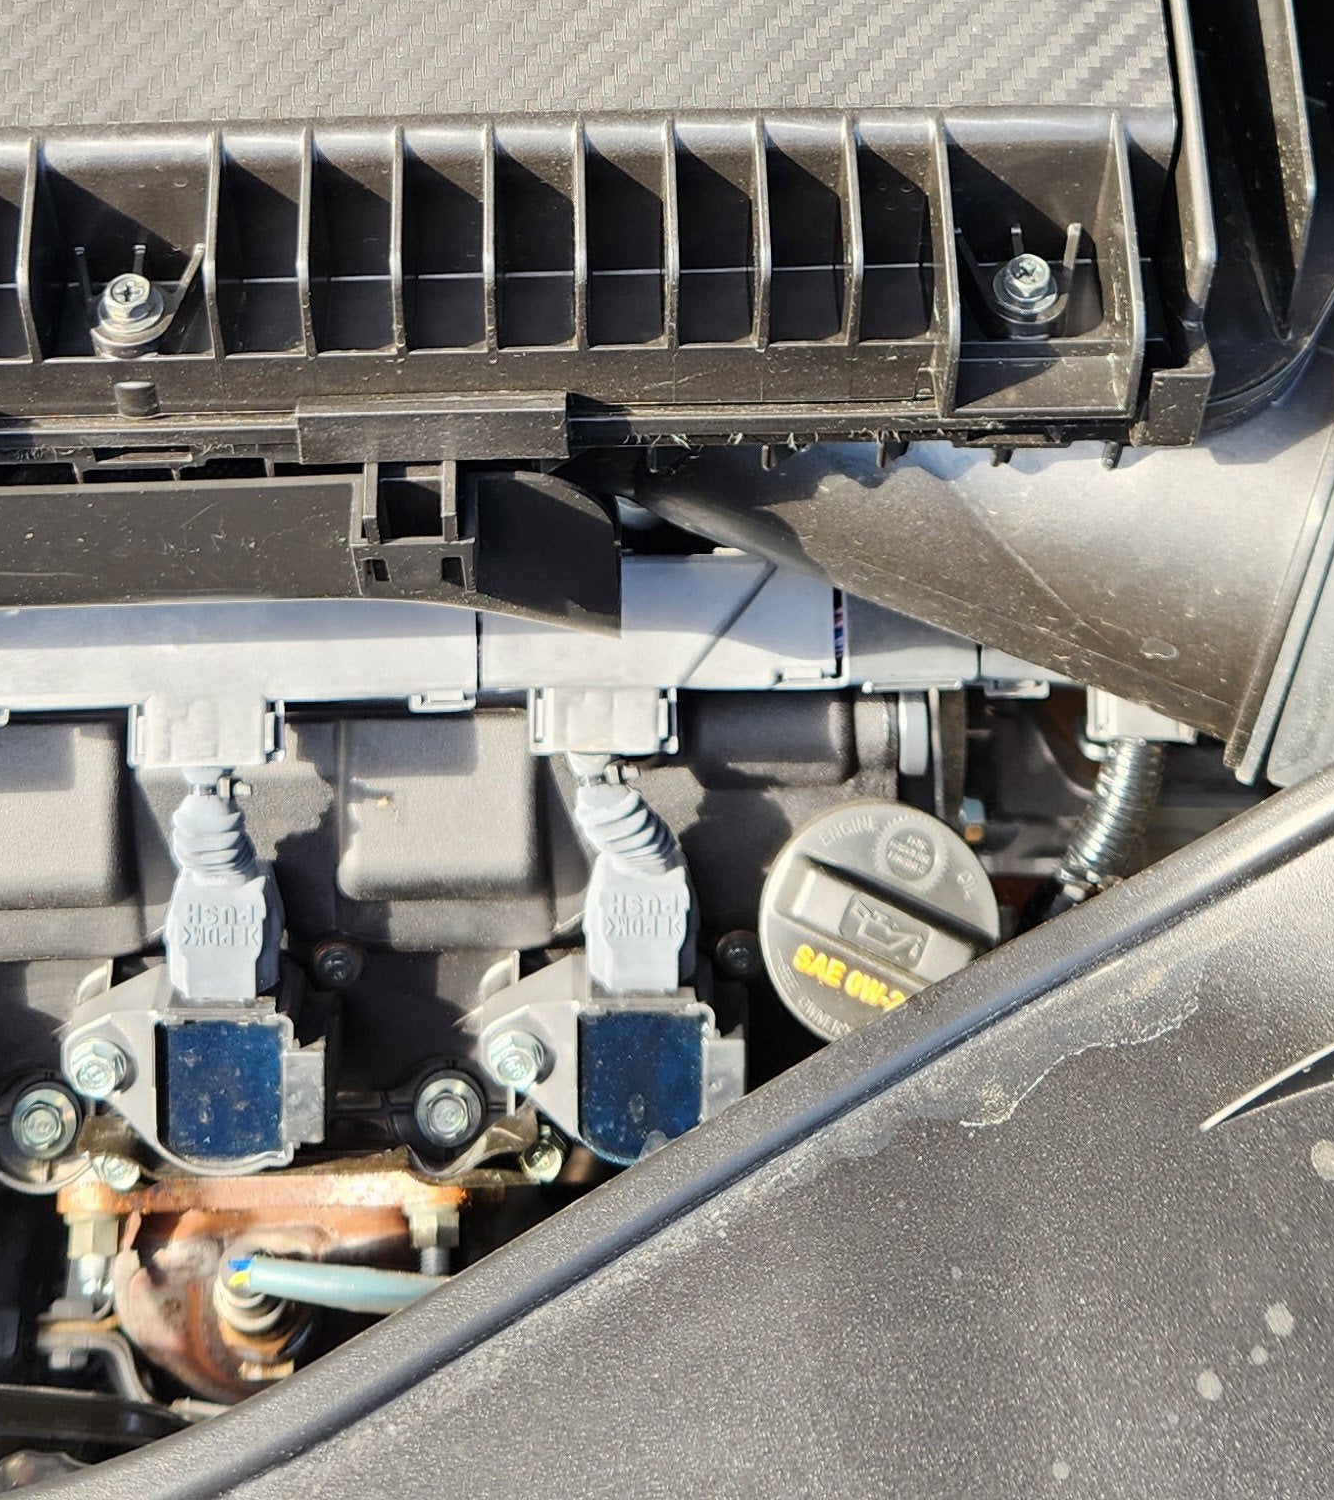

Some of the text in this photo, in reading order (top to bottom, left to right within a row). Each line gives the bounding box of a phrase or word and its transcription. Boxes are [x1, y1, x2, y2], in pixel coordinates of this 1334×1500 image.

[188, 903, 255, 925] PUSH
[613, 893, 678, 915] PUSH
[792, 944, 847, 989] SAE
